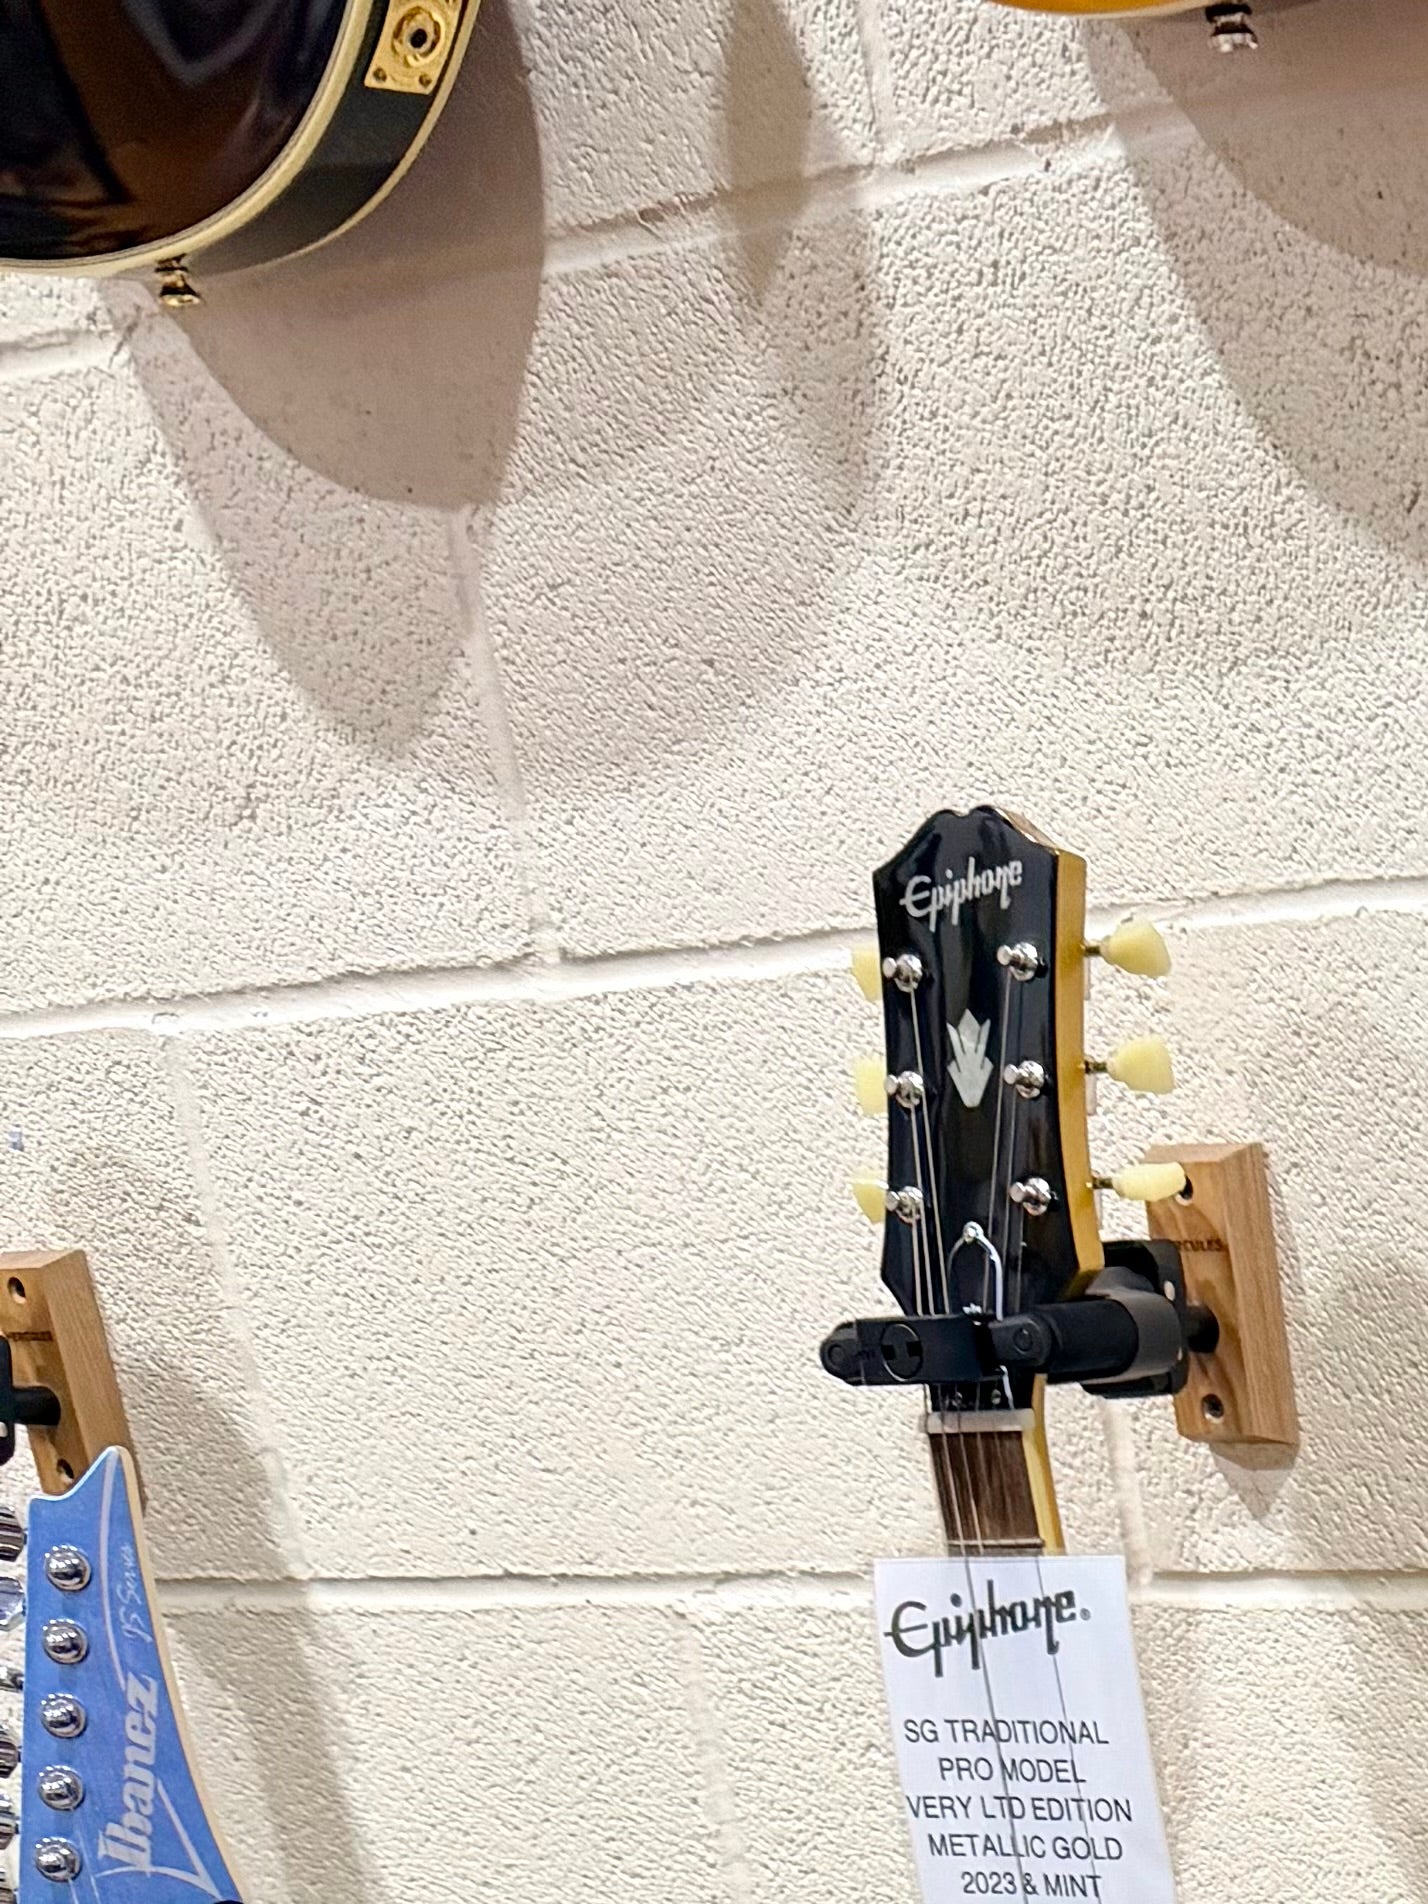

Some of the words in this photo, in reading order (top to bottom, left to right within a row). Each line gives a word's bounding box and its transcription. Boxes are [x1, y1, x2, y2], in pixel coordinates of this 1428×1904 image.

[899, 857, 1023, 933] Epiphone
[904, 1720, 938, 1743] SG
[944, 1720, 1109, 1745] TRADITIONAL
[97, 1672, 159, 1876] Ibanez
[938, 1758, 993, 1781] PRO
[1000, 1759, 1086, 1783] MODEL
[906, 1796, 971, 1819] VERY
[983, 1797, 1025, 1821] LTD
[1033, 1798, 1132, 1822] EDITION
[928, 1835, 1046, 1859] METALLIC
[1052, 1836, 1123, 1860] GOLD
[961, 1872, 1017, 1895] 2023
[1023, 1874, 1038, 1895] &
[1044, 1874, 1102, 1897] MINT
